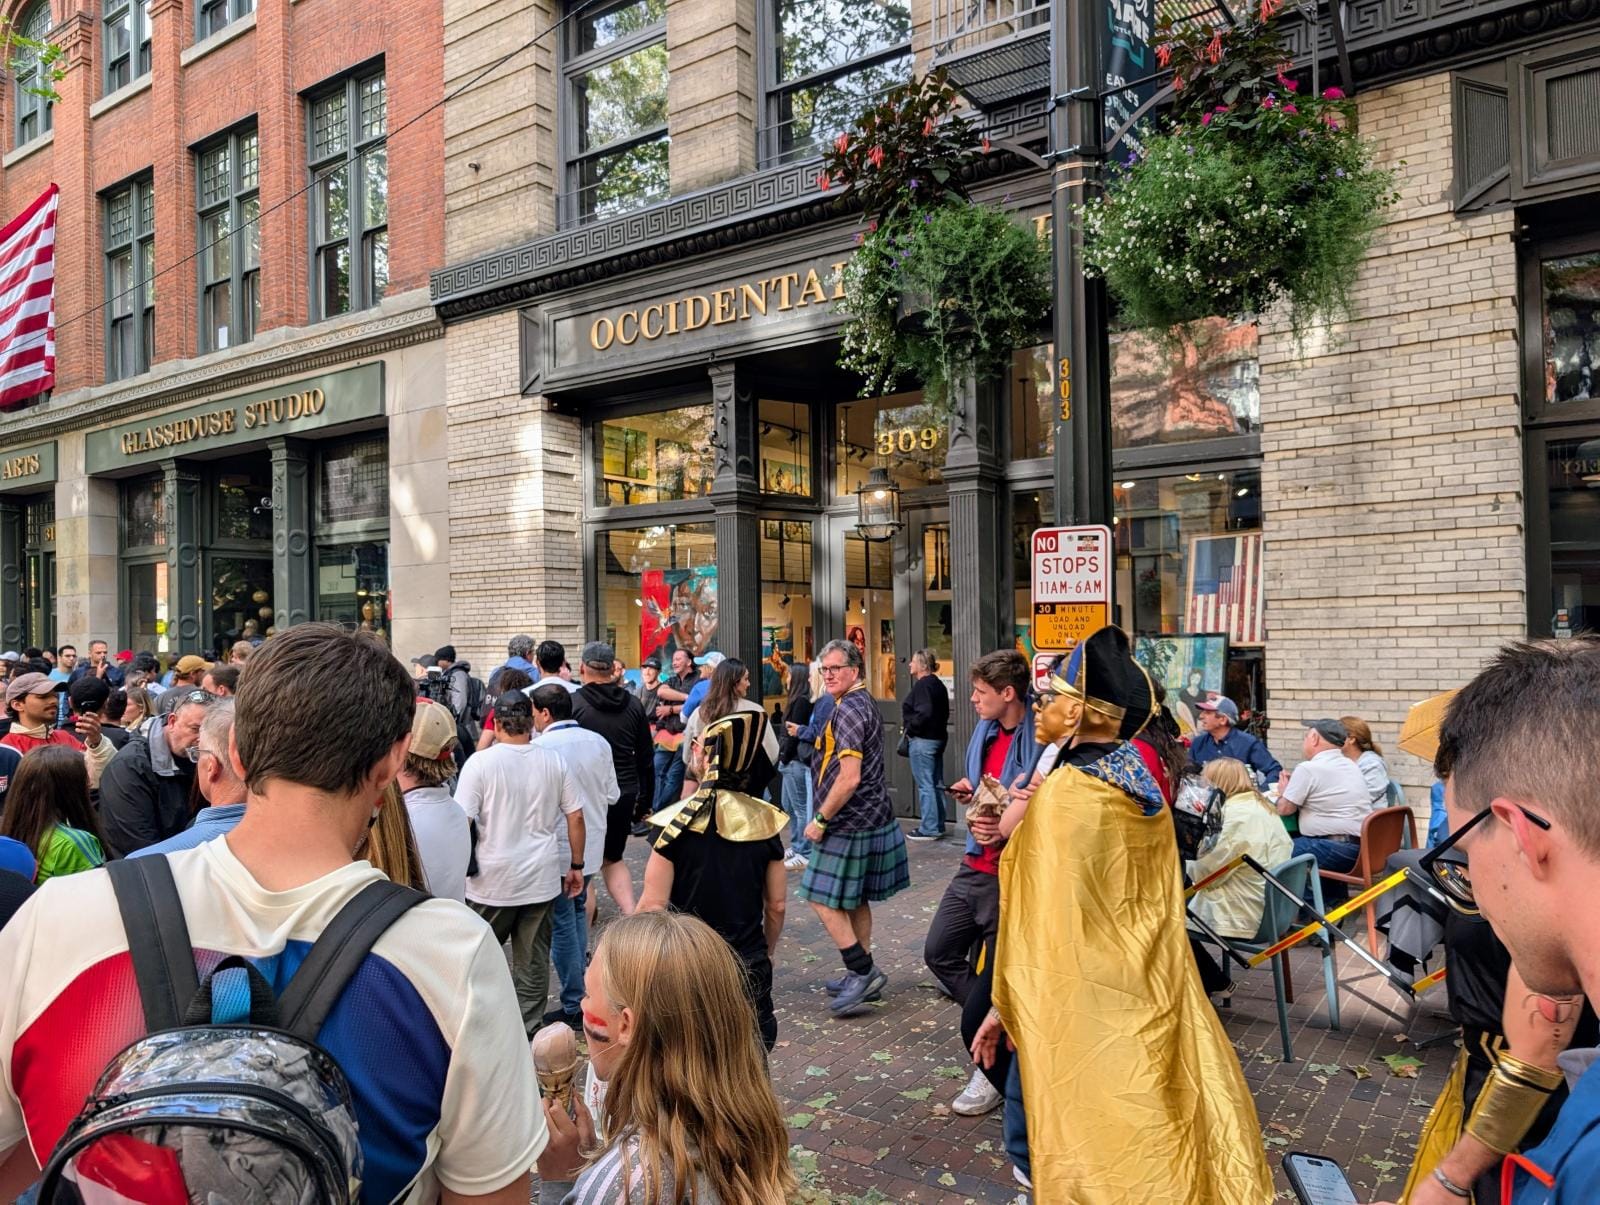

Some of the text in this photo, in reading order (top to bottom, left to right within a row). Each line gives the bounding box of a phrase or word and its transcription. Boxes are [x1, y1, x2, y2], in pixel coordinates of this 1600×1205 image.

[1060, 358, 1070, 420] 303
[120, 387, 325, 455] GLASSHOUSE STUDIO
[878, 426, 937, 455] 309
[2, 453, 40, 480] ARTS
[1037, 537, 1056, 551] NO
[1042, 556, 1099, 575] STOPS
[1040, 580, 1102, 594] 11AM-6AM
[1038, 604, 1095, 614] 30 MINUTE
